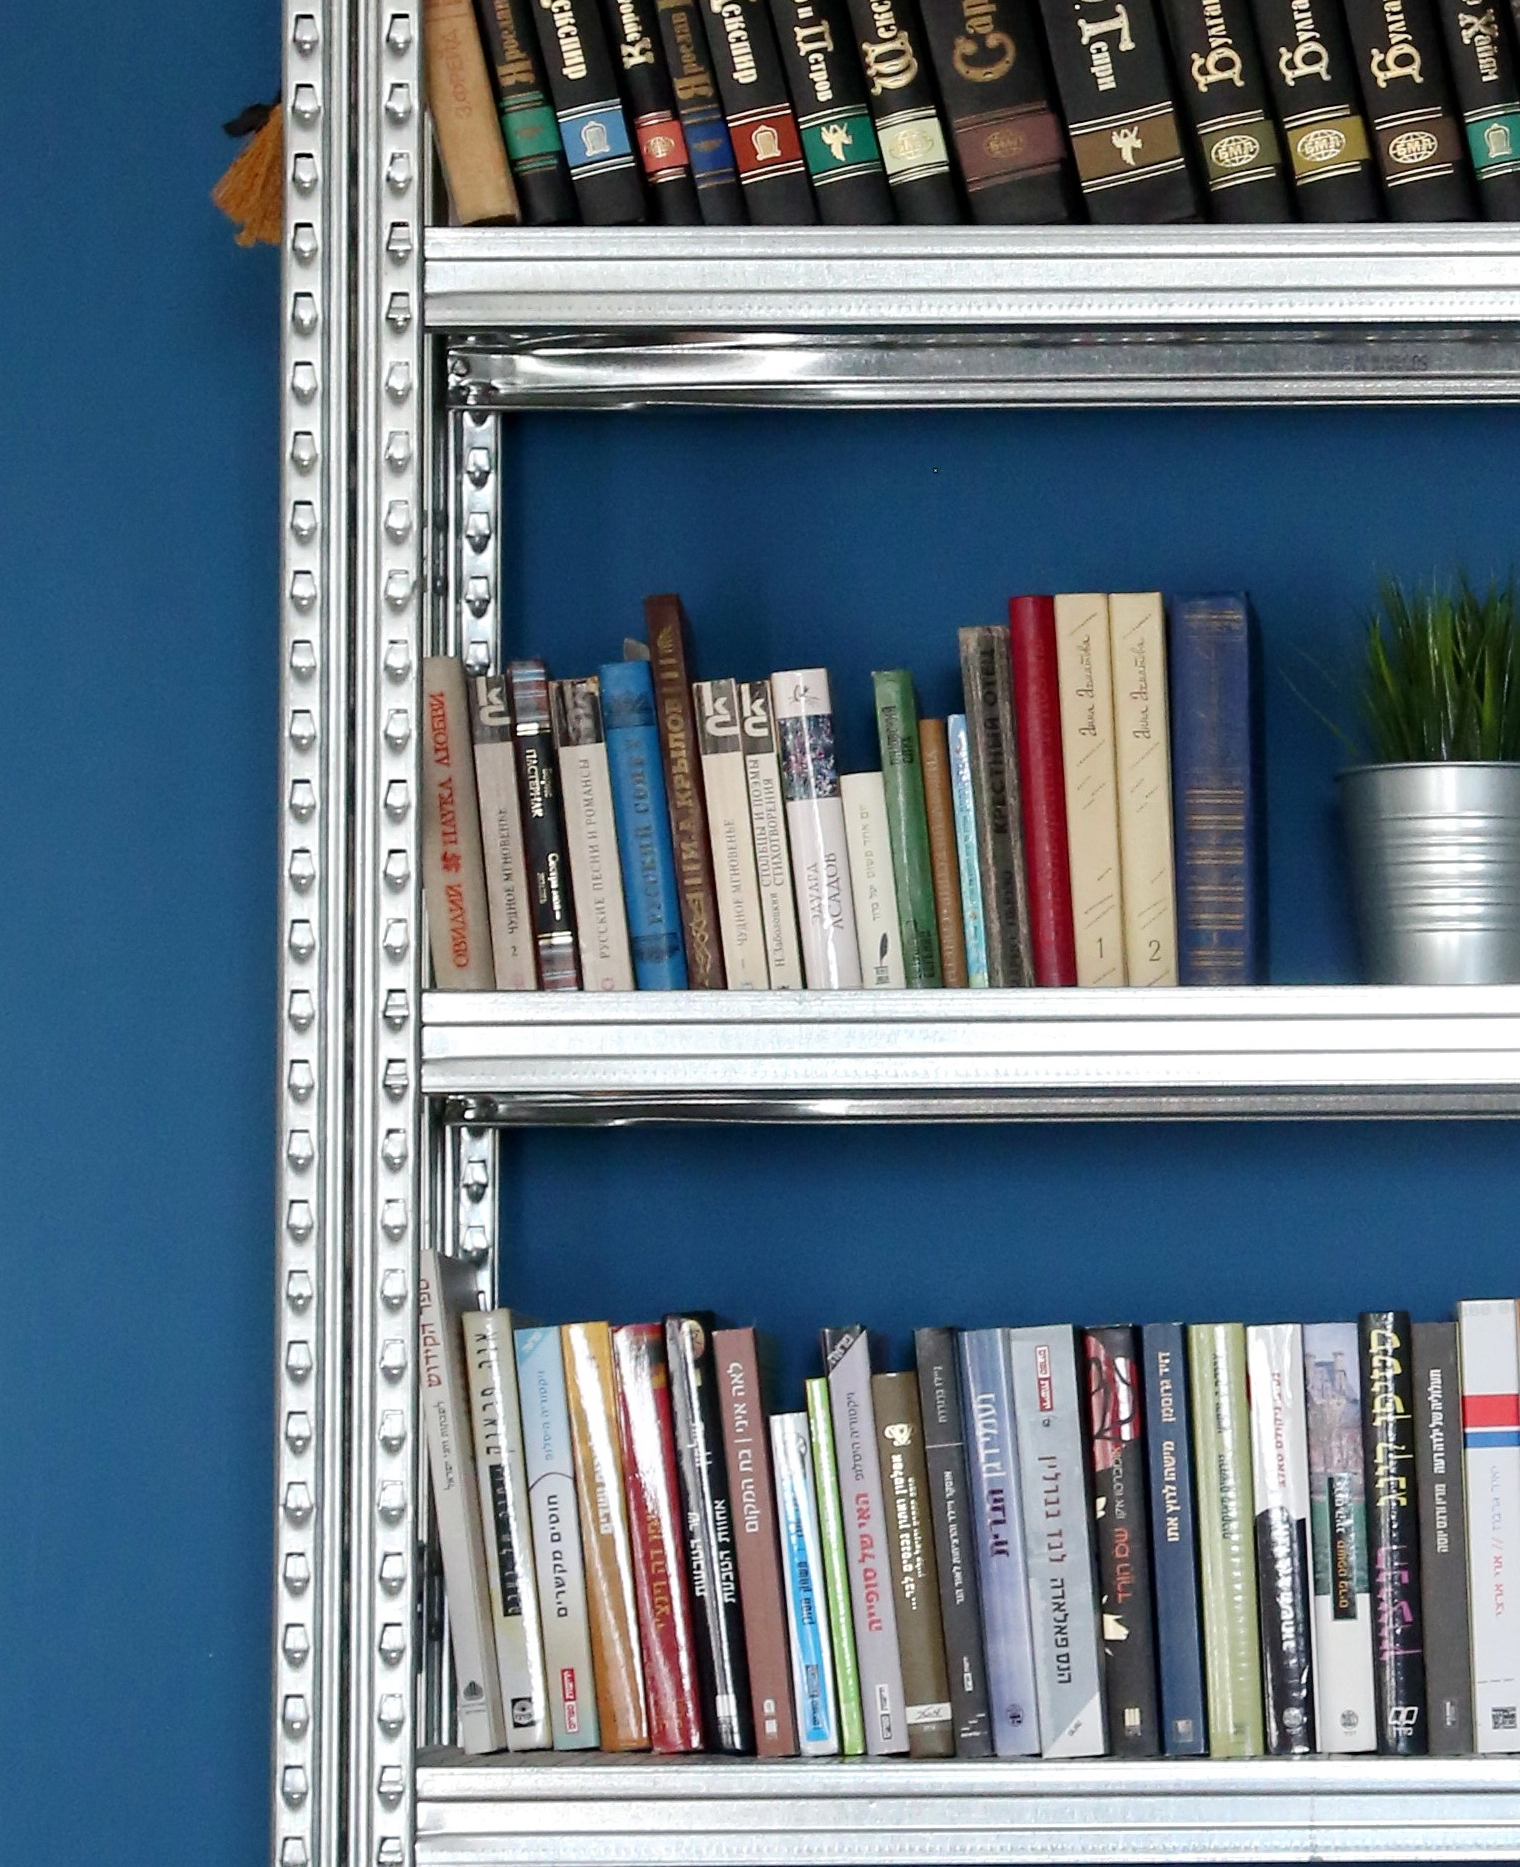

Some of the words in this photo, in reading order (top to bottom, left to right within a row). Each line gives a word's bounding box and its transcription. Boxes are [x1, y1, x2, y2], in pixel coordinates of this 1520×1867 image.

[795, 20, 835, 102] Петров
[579, 758, 595, 825] РОМАНСЫ
[588, 844, 603, 890] ПЕСНИ
[824, 852, 844, 930] АСАДОВ
[593, 897, 611, 959] РУССКИЕ
[1096, 937, 1106, 959] 1
[1148, 939, 1161, 961] 2
[728, 1362, 745, 1397] לאה
[731, 1402, 749, 1433] איני
[737, 1449, 753, 1471] בת
[1161, 1441, 1176, 1482] מישהו
[545, 1494, 562, 1542] חוטים
[741, 1477, 761, 1533] המקום
[853, 1493, 870, 1526] האי
[1161, 1485, 1179, 1512] לרוץ
[856, 1534, 876, 1561] של
[1165, 1517, 1180, 1542] אתו
[550, 1550, 569, 1618] מקשרים
[861, 1568, 883, 1632] סופייה
